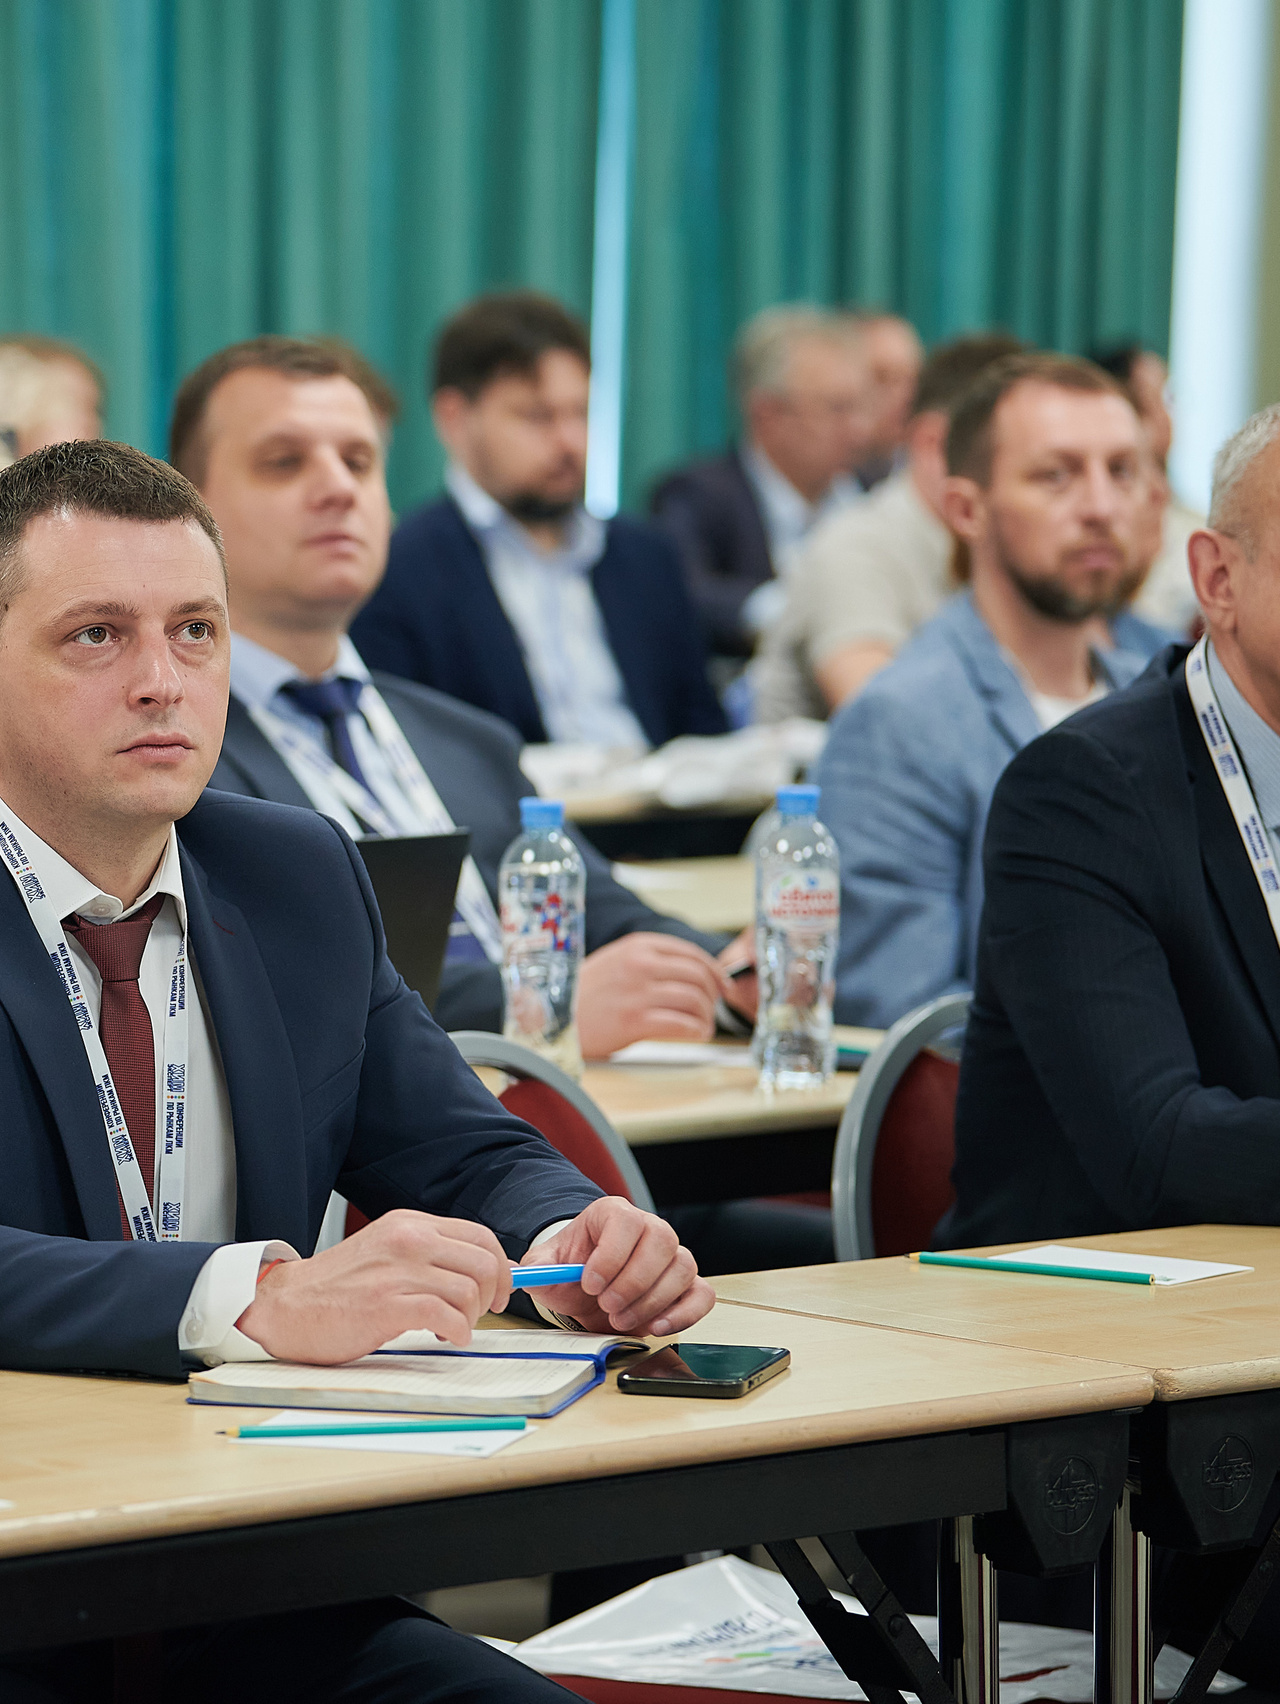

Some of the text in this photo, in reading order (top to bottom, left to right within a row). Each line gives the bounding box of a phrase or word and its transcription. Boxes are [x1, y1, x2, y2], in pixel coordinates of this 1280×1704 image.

[6, 833, 25, 857] РЫНКАМ
[20, 855, 29, 865] ПО
[18, 872, 42, 903] ХИМ
[29, 871, 46, 898] ЭКСПЕРТ
[57, 941, 81, 993] ПО РЫНКАМ ЛКМ
[177, 964, 186, 1010] КОНФЕРЕНЦИИ
[170, 1063, 185, 1092] ХИМ
[95, 1083, 115, 1128] КОНФЕРЕНЦИИ
[101, 1073, 122, 1125] ПО РЫНКАМ ЛКМ
[165, 1102, 174, 1154] ПО РЫНКАМ ЛКМ
[174, 1102, 184, 1147] КОНФЕРЕНЦИИ
[110, 1134, 131, 1165] ХИМ
[120, 1133, 134, 1161] ЭКСПЕРТ
[139, 1205, 151, 1222] ЛКМ
[165, 1202, 180, 1231] ХИМ
